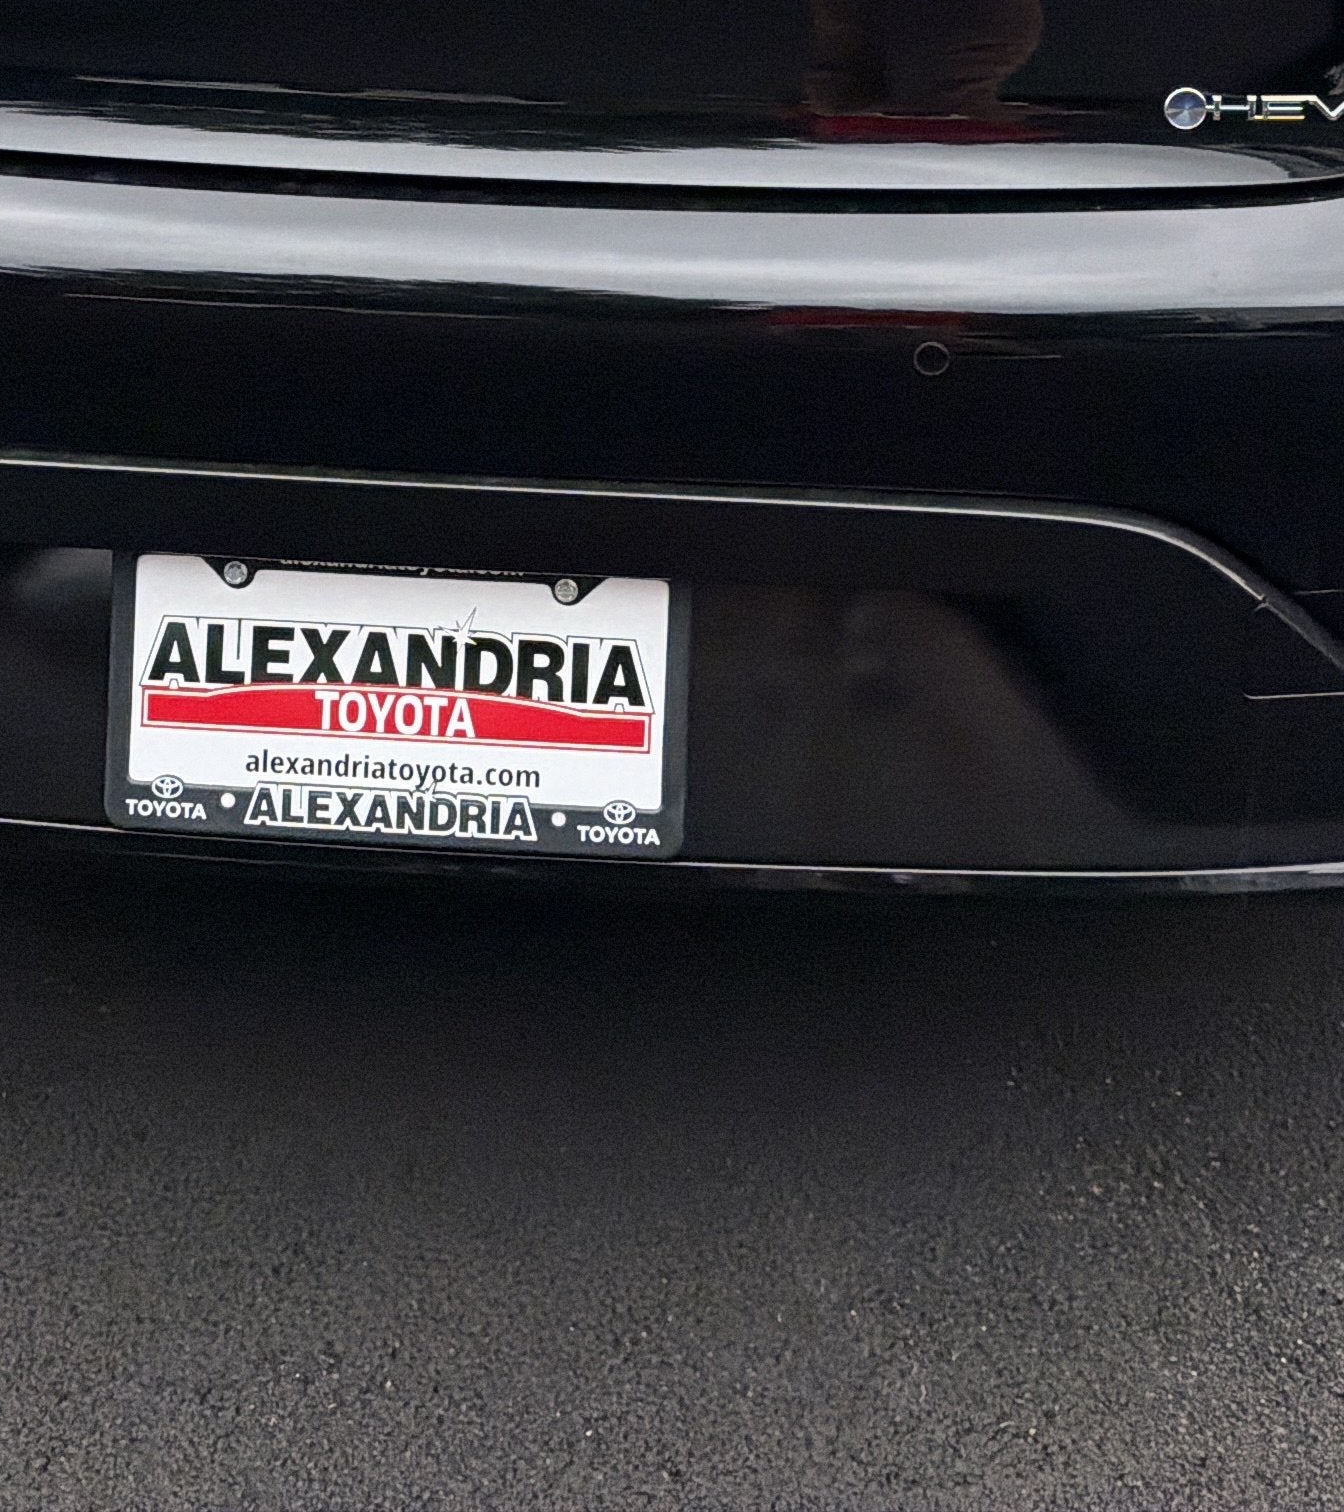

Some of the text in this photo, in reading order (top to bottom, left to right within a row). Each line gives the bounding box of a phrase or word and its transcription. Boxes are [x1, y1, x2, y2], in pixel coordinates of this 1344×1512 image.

[144, 617, 648, 711] ALEXANDRIA
[315, 689, 476, 739] TOYOTA
[245, 749, 541, 790] alexandriatoyota.com
[125, 797, 207, 822] TOYOTA
[243, 783, 538, 841] ALEXANDRIA
[577, 823, 661, 848] TOYOTA
